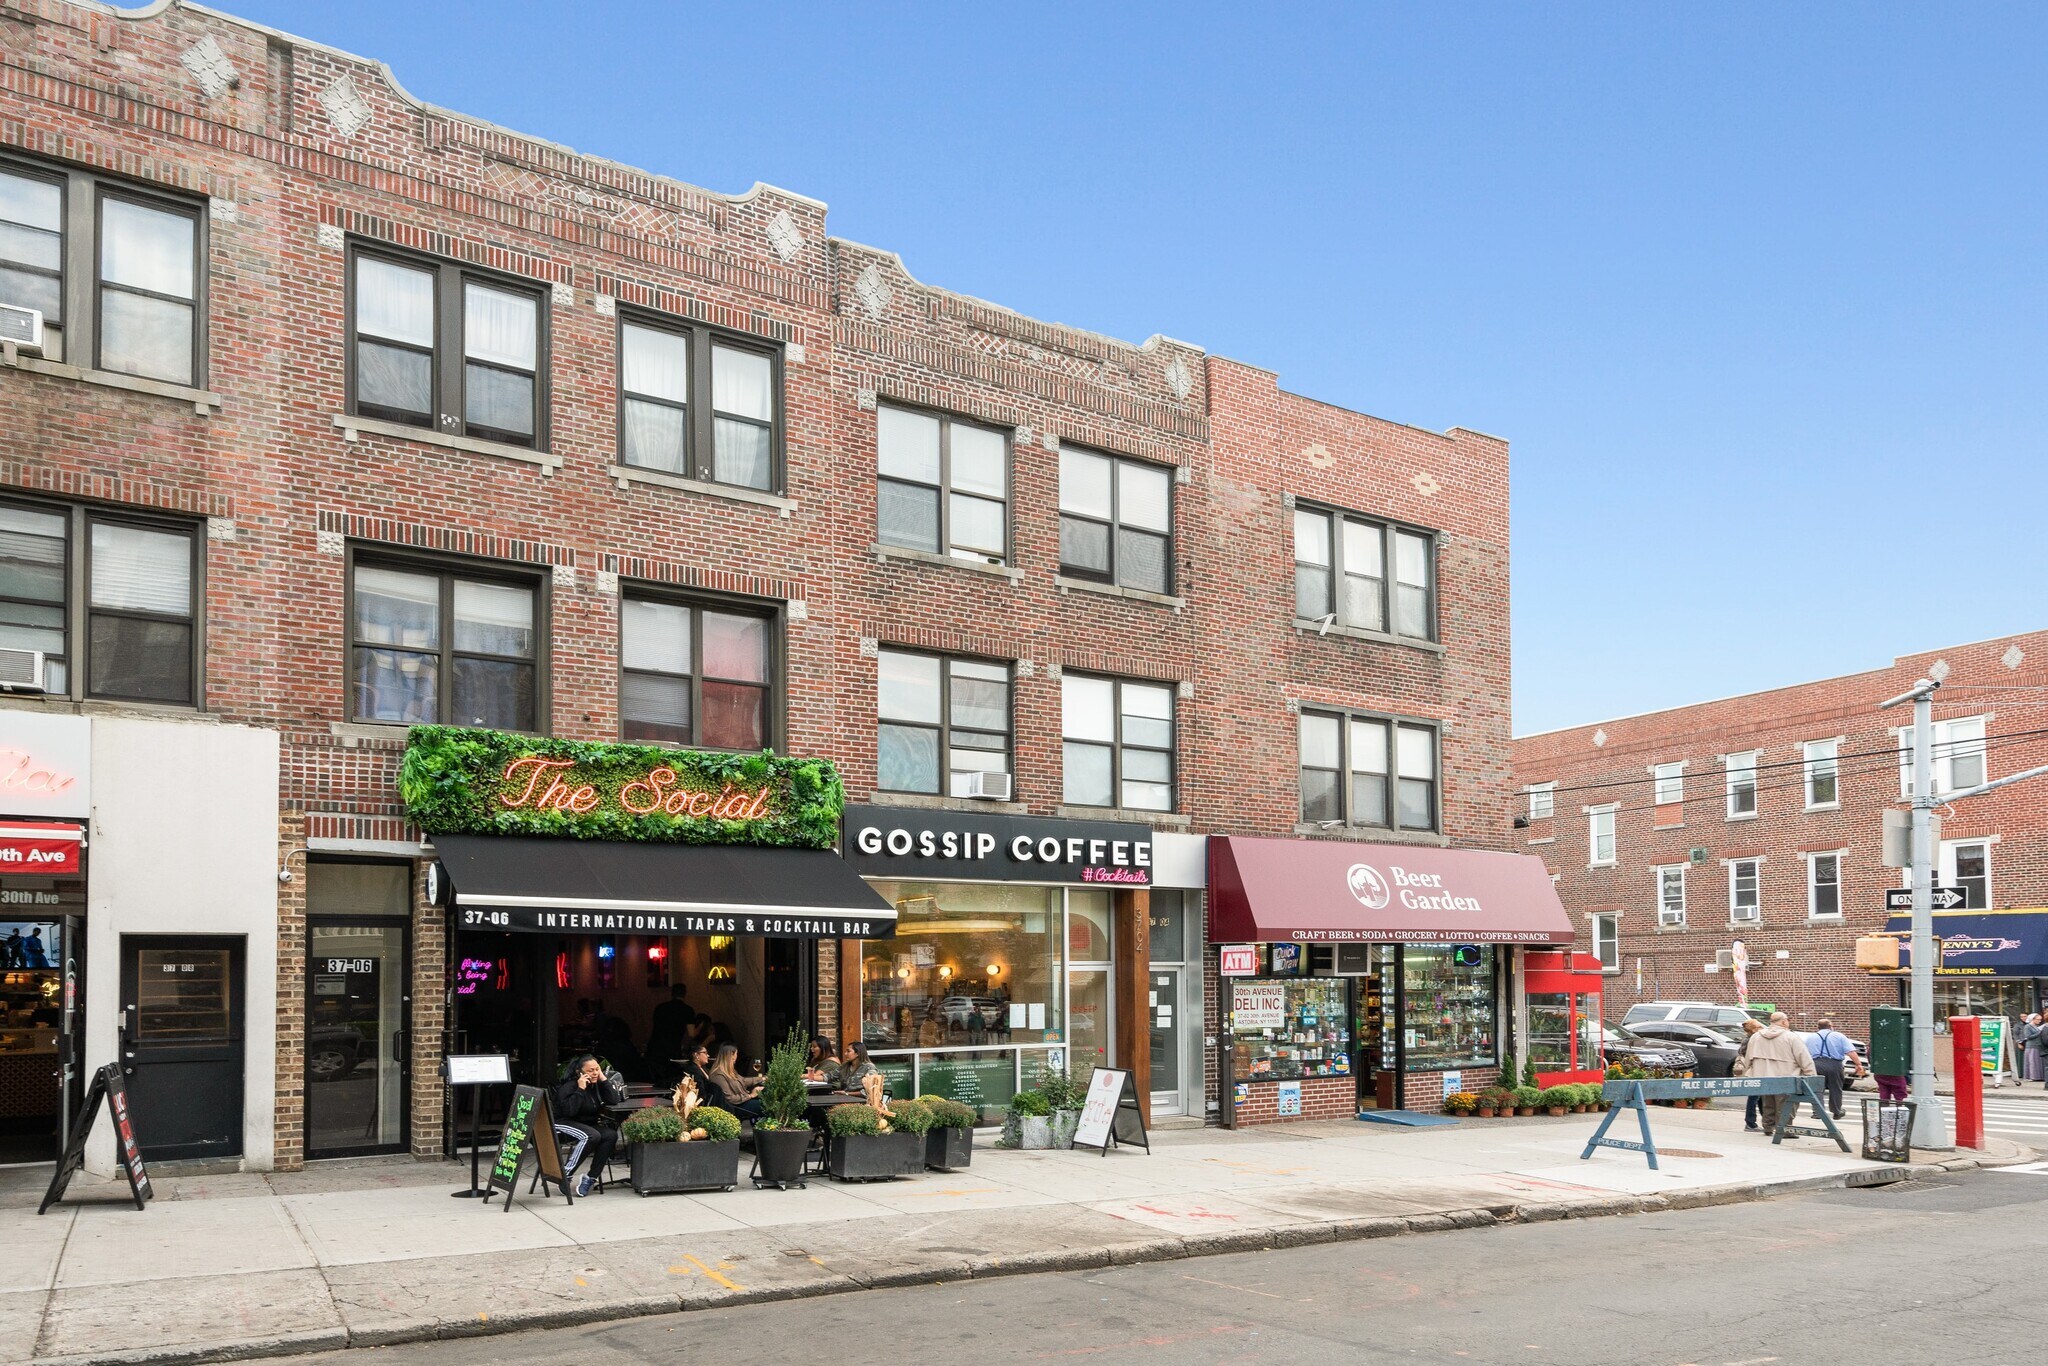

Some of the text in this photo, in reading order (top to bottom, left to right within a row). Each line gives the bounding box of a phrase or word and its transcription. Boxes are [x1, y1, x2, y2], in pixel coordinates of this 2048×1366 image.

[501, 758, 769, 820] The Social
[857, 826, 1151, 867] GOSSIP COFFEE
[0, 848, 66, 863] th Ave
[1081, 867, 1149, 883] #Cocktails
[1389, 866, 1442, 888] Beer
[1, 891, 59, 905] 30th Ave
[1400, 889, 1482, 911] Garden
[1897, 894, 1955, 904] ON WAY
[464, 910, 870, 934] 37-06 INTERNATIONAL TAPAS & COCKTAIL BAR
[1292, 930, 1550, 940] CRAFT BEER SODA GROCERY LOTTO COFFEE SNACKS
[1942, 941, 1994, 949] ENNY'S
[1275, 945, 1296, 960] Quick
[328, 959, 372, 973] 37-06
[1224, 953, 1251, 970] ATM
[1281, 958, 1299, 969] Draw
[1235, 988, 1282, 996] 30th AVENUE
[1235, 997, 1283, 1010] DELI INC.
[1051, 1052, 1061, 1064] A
[1681, 1081, 1700, 1090] POLICE
[1704, 1081, 1716, 1089] LINE
[1723, 1080, 1731, 1088] DO
[1732, 1080, 1743, 1088] NOT
[1744, 1080, 1761, 1088] CROSS
[1598, 1138, 1621, 1147] POLICE
